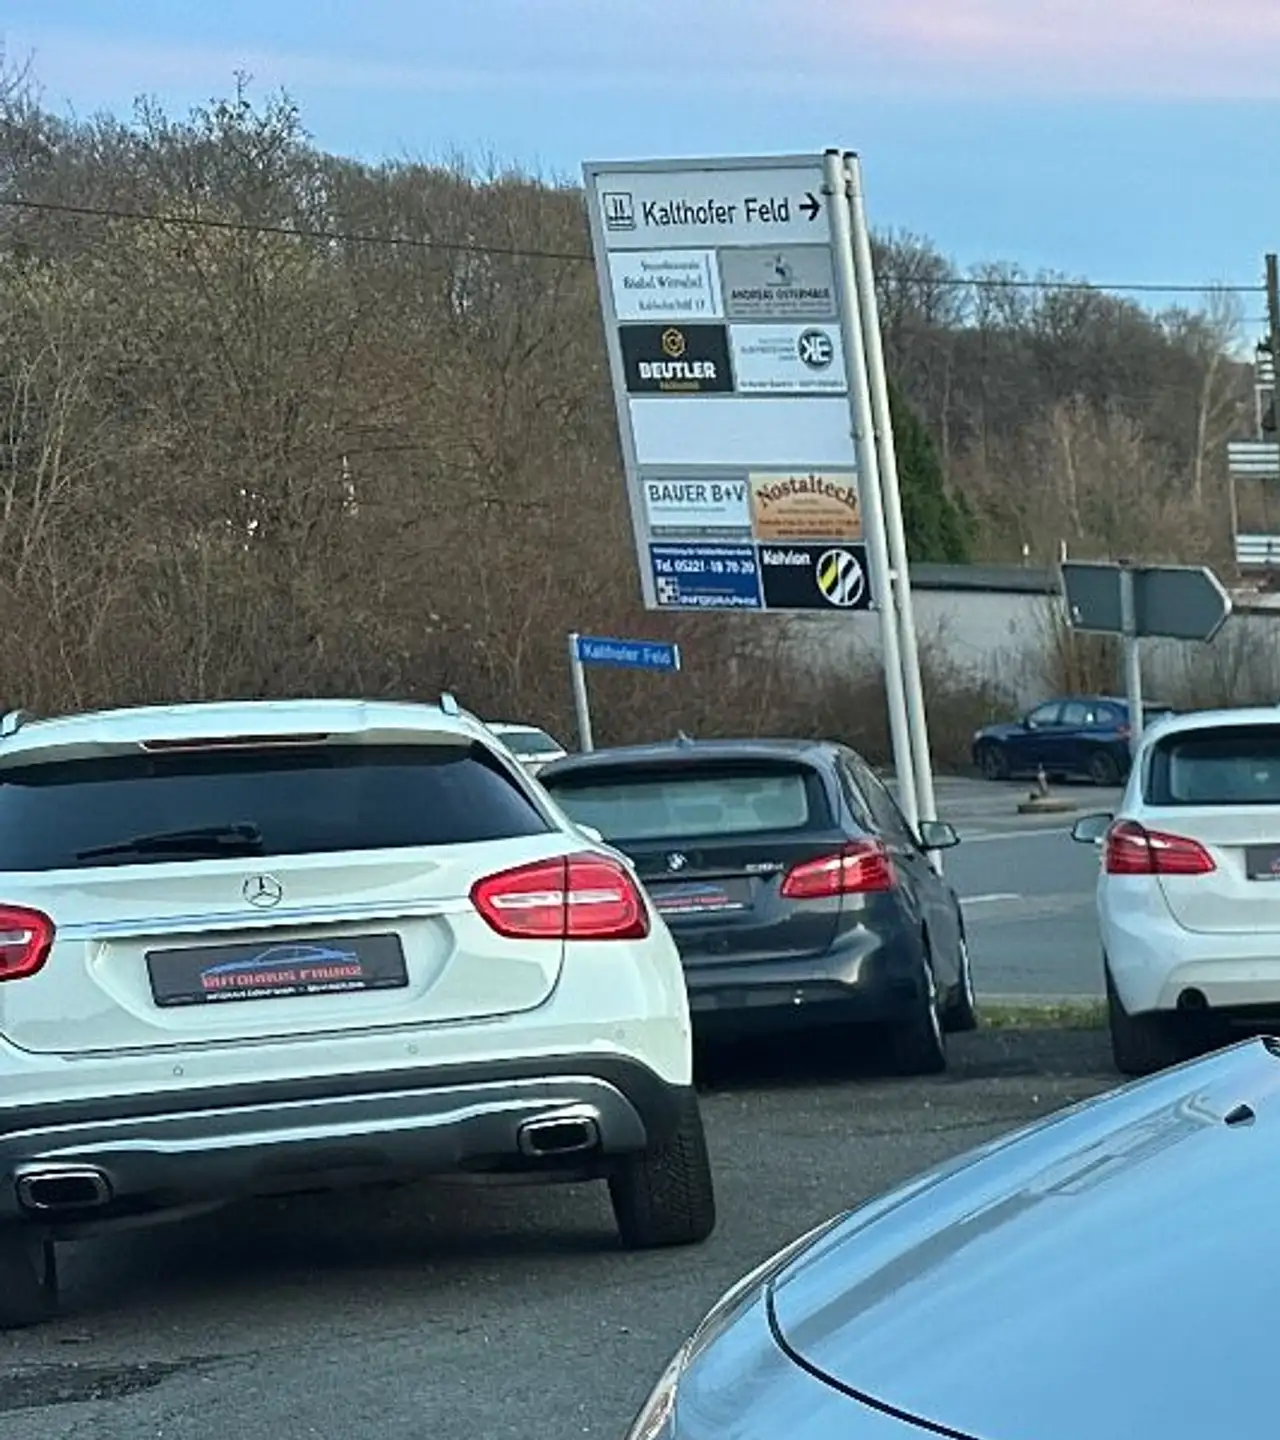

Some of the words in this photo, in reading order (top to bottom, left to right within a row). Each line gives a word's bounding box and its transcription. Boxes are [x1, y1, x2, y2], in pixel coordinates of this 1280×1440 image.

[641, 199, 737, 227] Kalthofer
[744, 197, 791, 223] Feld
[638, 361, 717, 380] BEUTLER
[648, 484, 707, 502] BAUER
[712, 484, 745, 502] B+V
[755, 474, 859, 511] Nostaltech
